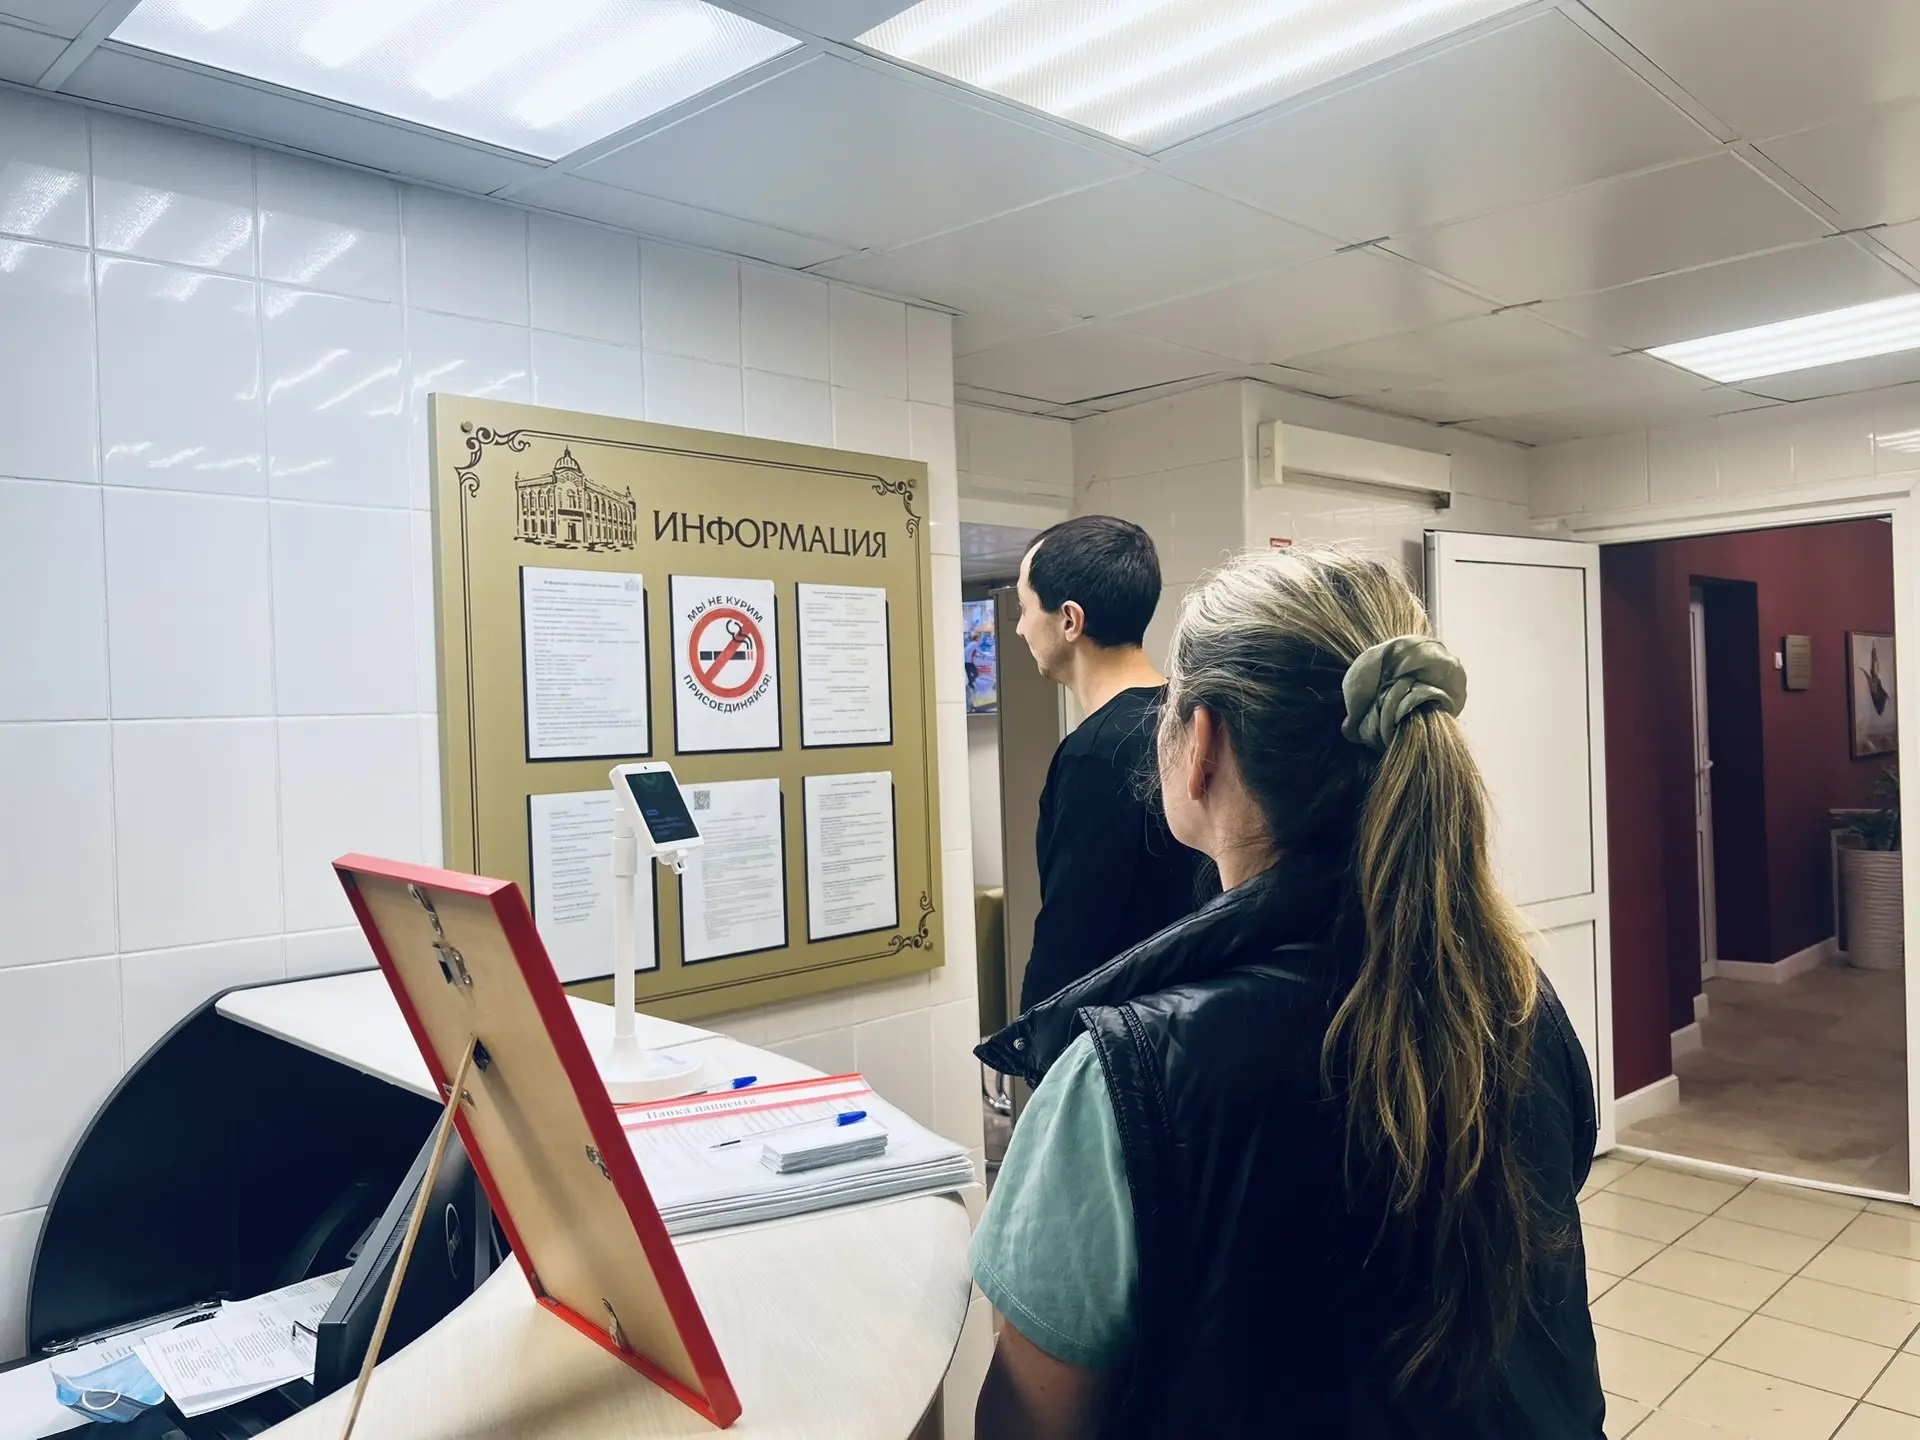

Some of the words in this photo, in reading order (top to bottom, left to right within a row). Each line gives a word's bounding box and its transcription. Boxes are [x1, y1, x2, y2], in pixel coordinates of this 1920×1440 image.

[653, 510, 887, 558] ИНФОРМАЦИЯ
[687, 602, 706, 622] МЫ
[707, 595, 723, 607] НЕ
[726, 596, 764, 623] КУРИМ
[683, 673, 773, 714] ПРИСОЕДИНЯЙСЯ!
[646, 1109, 691, 1120] Папка
[695, 1099, 757, 1113] пациента
